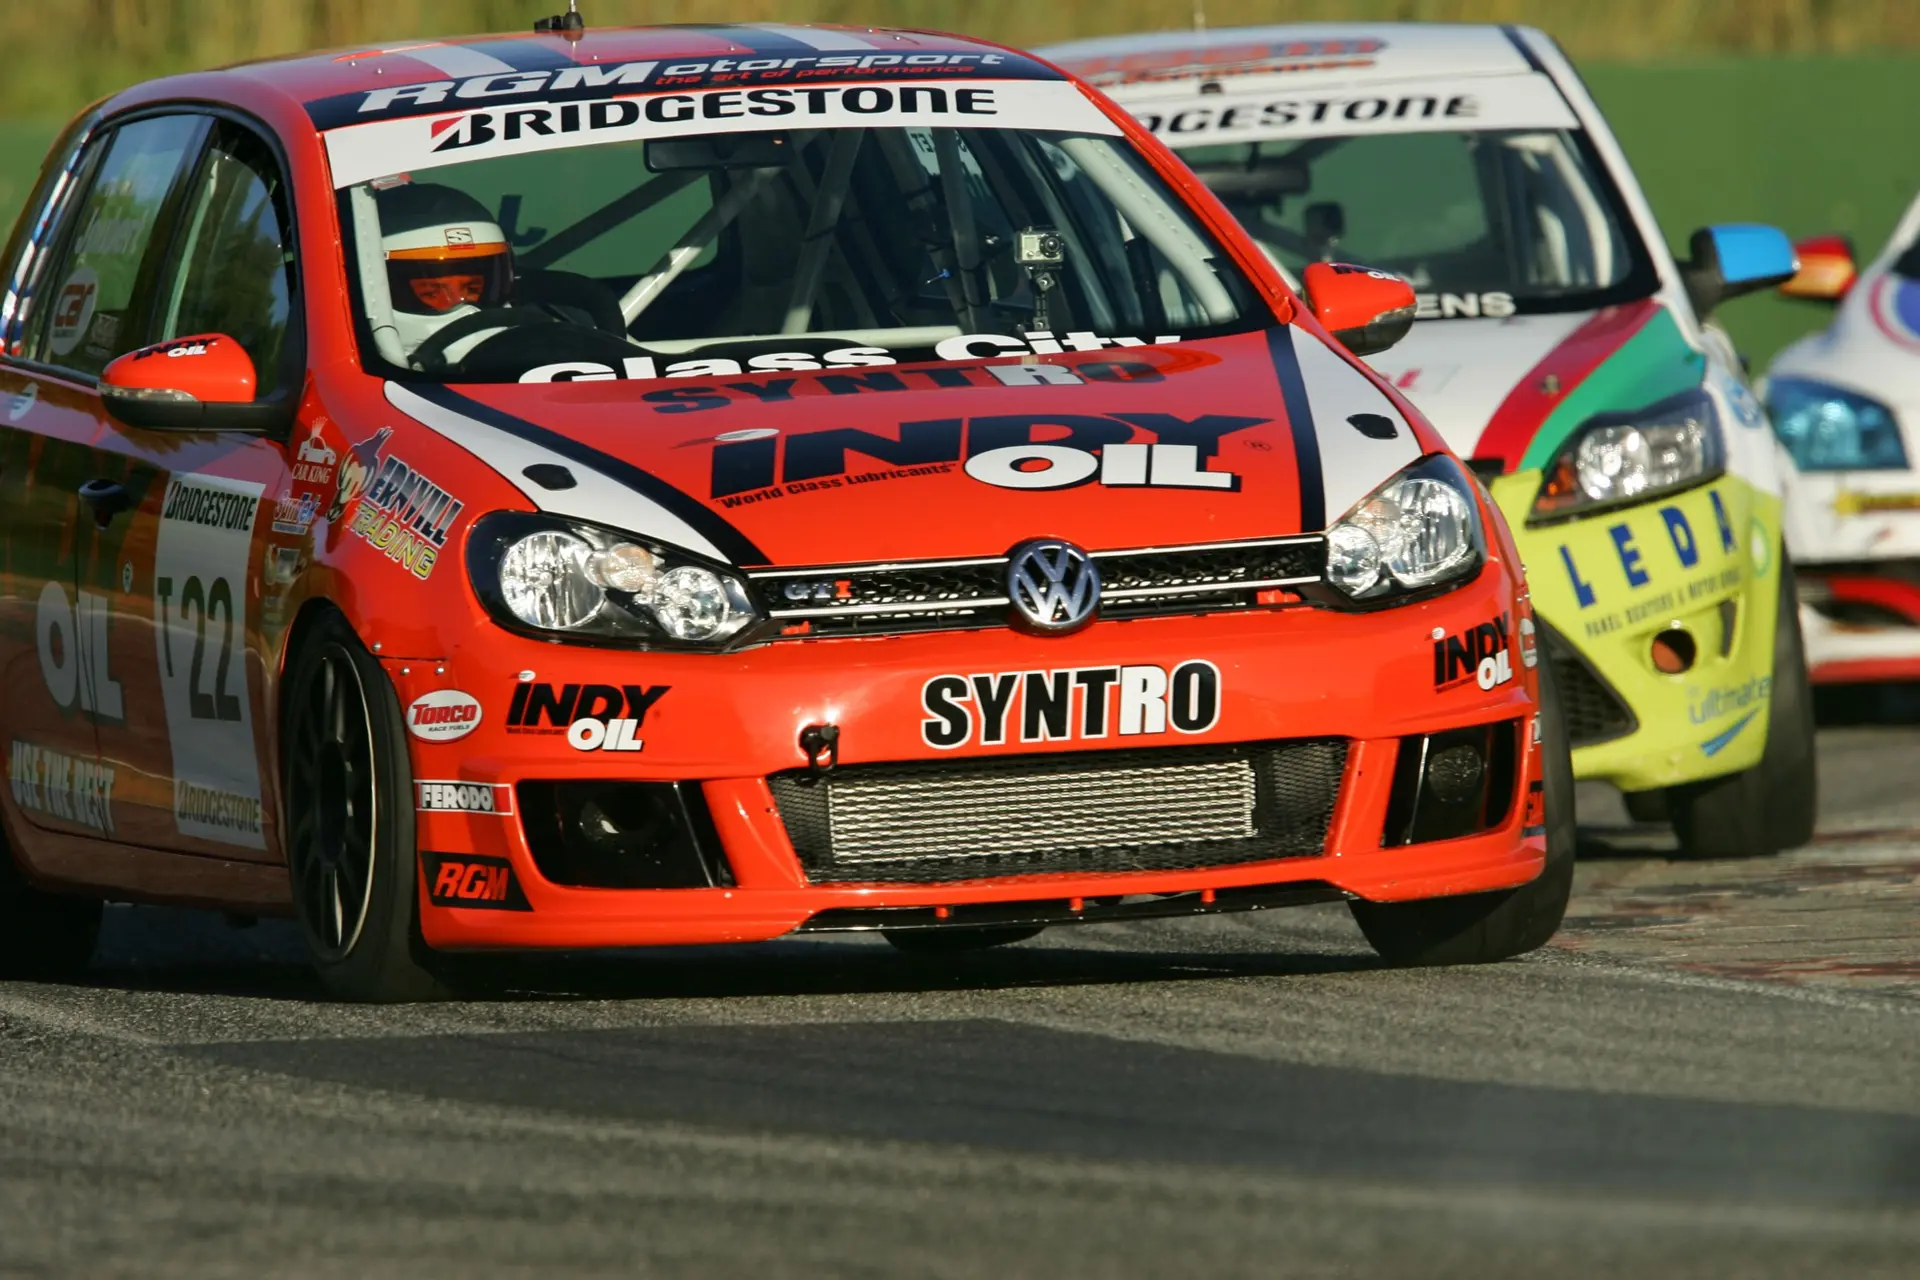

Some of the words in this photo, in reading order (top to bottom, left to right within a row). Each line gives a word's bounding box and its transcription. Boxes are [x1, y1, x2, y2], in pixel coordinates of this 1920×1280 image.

[655, 75, 703, 86] the
[710, 71, 753, 82] art
[760, 68, 791, 79] of
[796, 64, 976, 79] performance
[432, 86, 998, 152] BRIDGESTONE
[167, 345, 207, 358] OIL
[641, 361, 1167, 414] SYNTRO
[308, 464, 333, 484] KING
[722, 484, 784, 509] World
[786, 478, 844, 495] Class
[846, 463, 952, 485] Lubricants
[963, 443, 1242, 492] OIL
[164, 480, 257, 532] BRIDGESTONE
[349, 500, 438, 581] TRADING
[784, 580, 853, 600] GTI
[36, 580, 124, 721] OIL
[1477, 648, 1513, 691] OIL
[412, 703, 478, 725] TORCO
[921, 658, 1223, 749] SYNTRO
[567, 717, 644, 751] OIL
[42, 750, 74, 820] THE
[421, 784, 494, 812] FERODO
[433, 862, 510, 901] RGM
